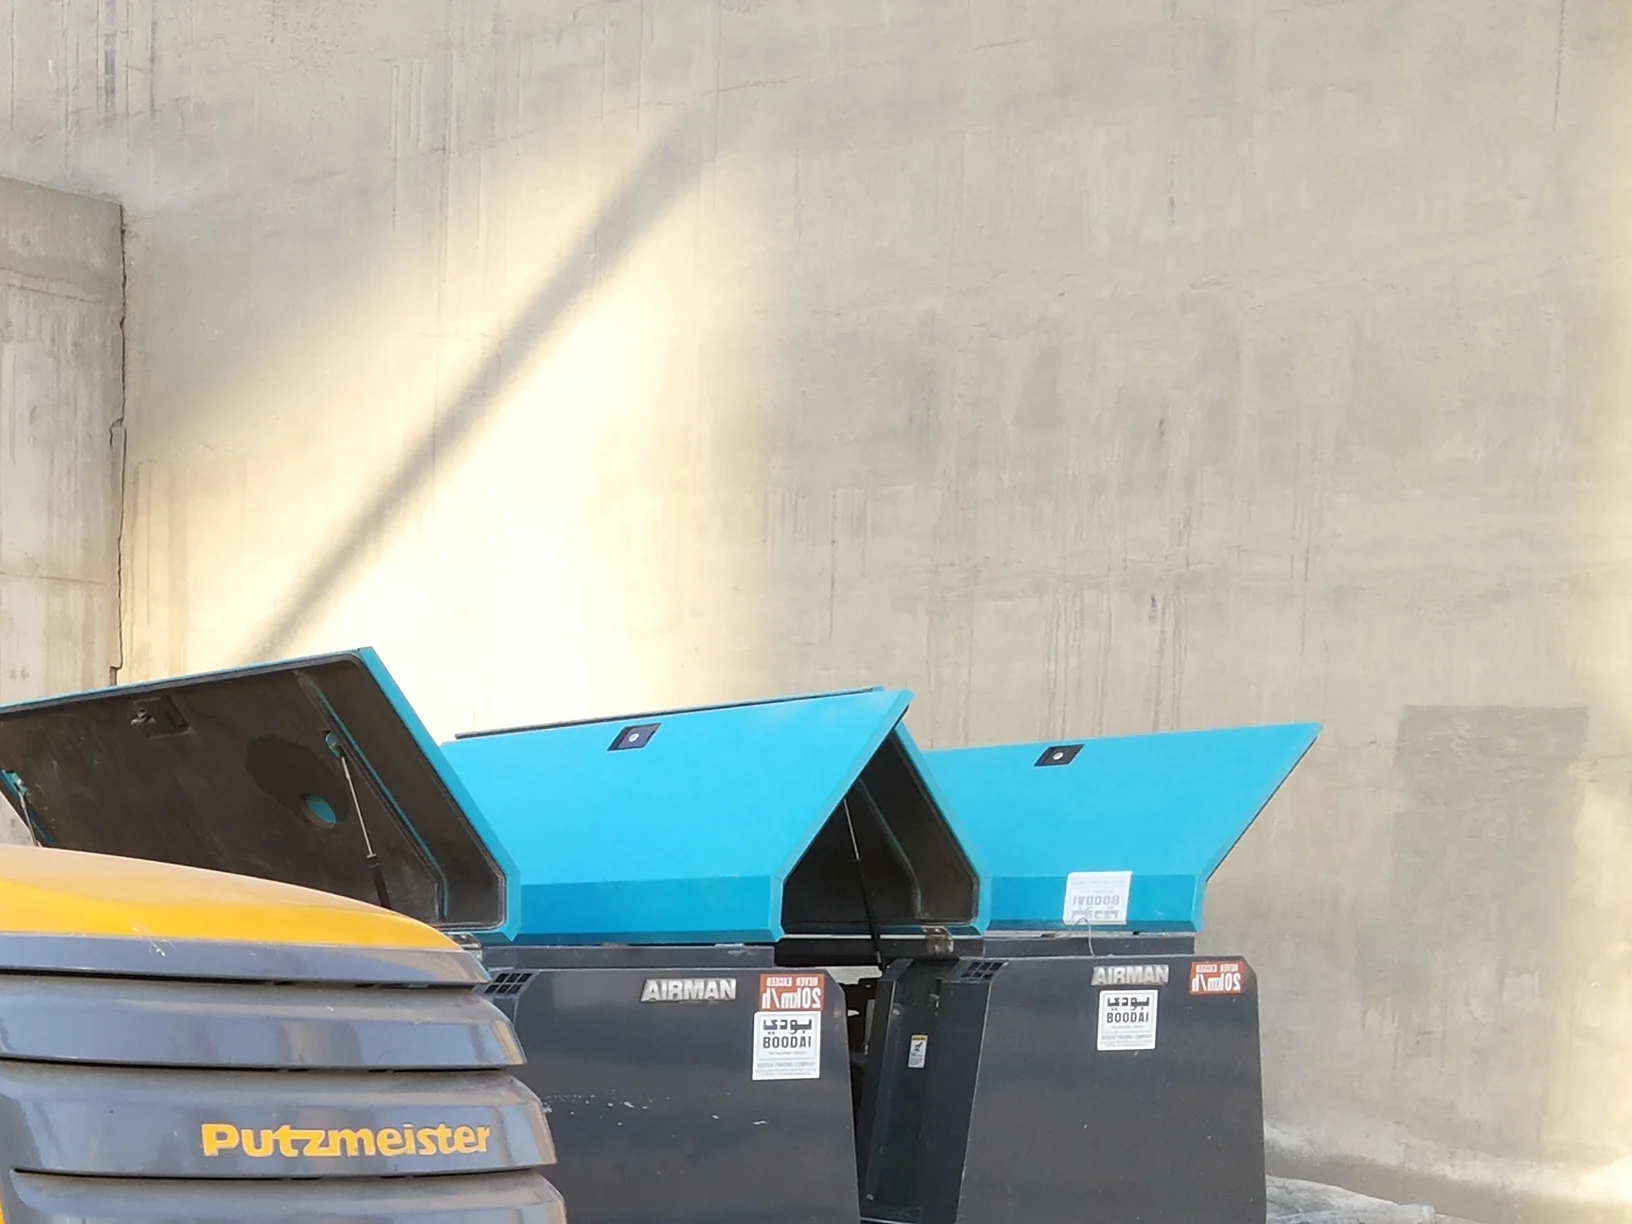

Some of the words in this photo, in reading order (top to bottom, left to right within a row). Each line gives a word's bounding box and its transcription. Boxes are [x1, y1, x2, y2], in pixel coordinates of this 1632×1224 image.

[1091, 964, 1169, 986] AIRMAN
[640, 978, 736, 1002] AIRMAN
[1106, 1012, 1149, 1023] BOODAI
[763, 1036, 811, 1049] BOODAI
[201, 1122, 490, 1158] Putzmeister
